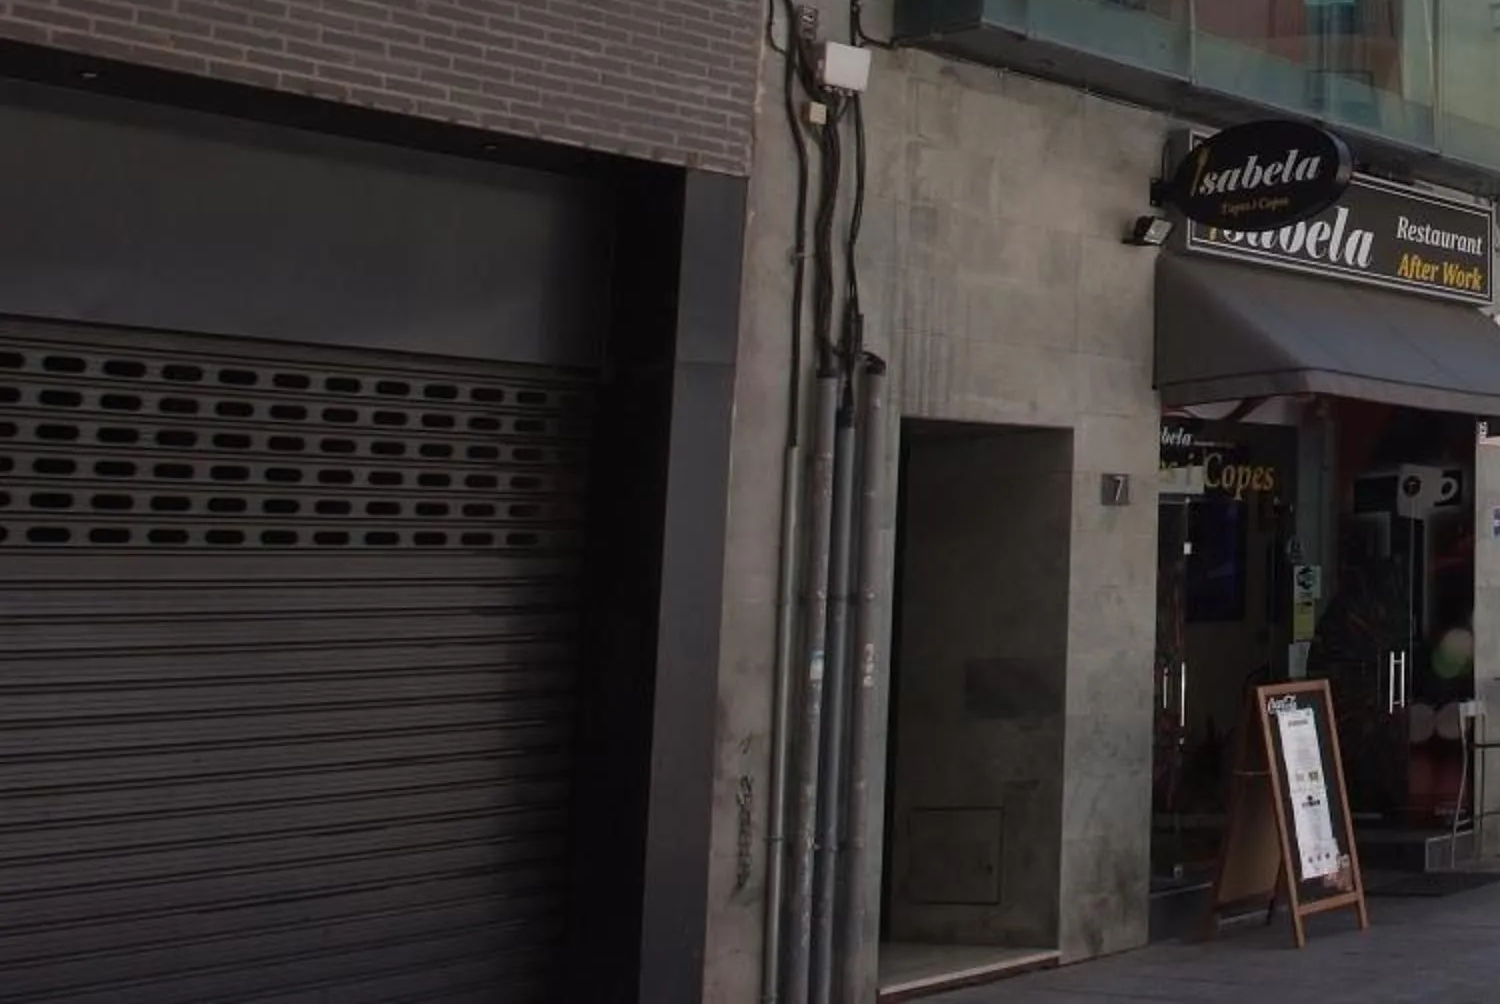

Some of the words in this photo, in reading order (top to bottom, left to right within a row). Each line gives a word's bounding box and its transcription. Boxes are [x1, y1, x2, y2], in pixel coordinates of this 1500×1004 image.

[1191, 146, 1321, 197] Isabela
[1396, 215, 1483, 256] Restaurant
[1397, 253, 1440, 282] After
[1443, 260, 1483, 292] Work
[1111, 475, 1126, 502] 7
[1203, 451, 1275, 501] Copes
